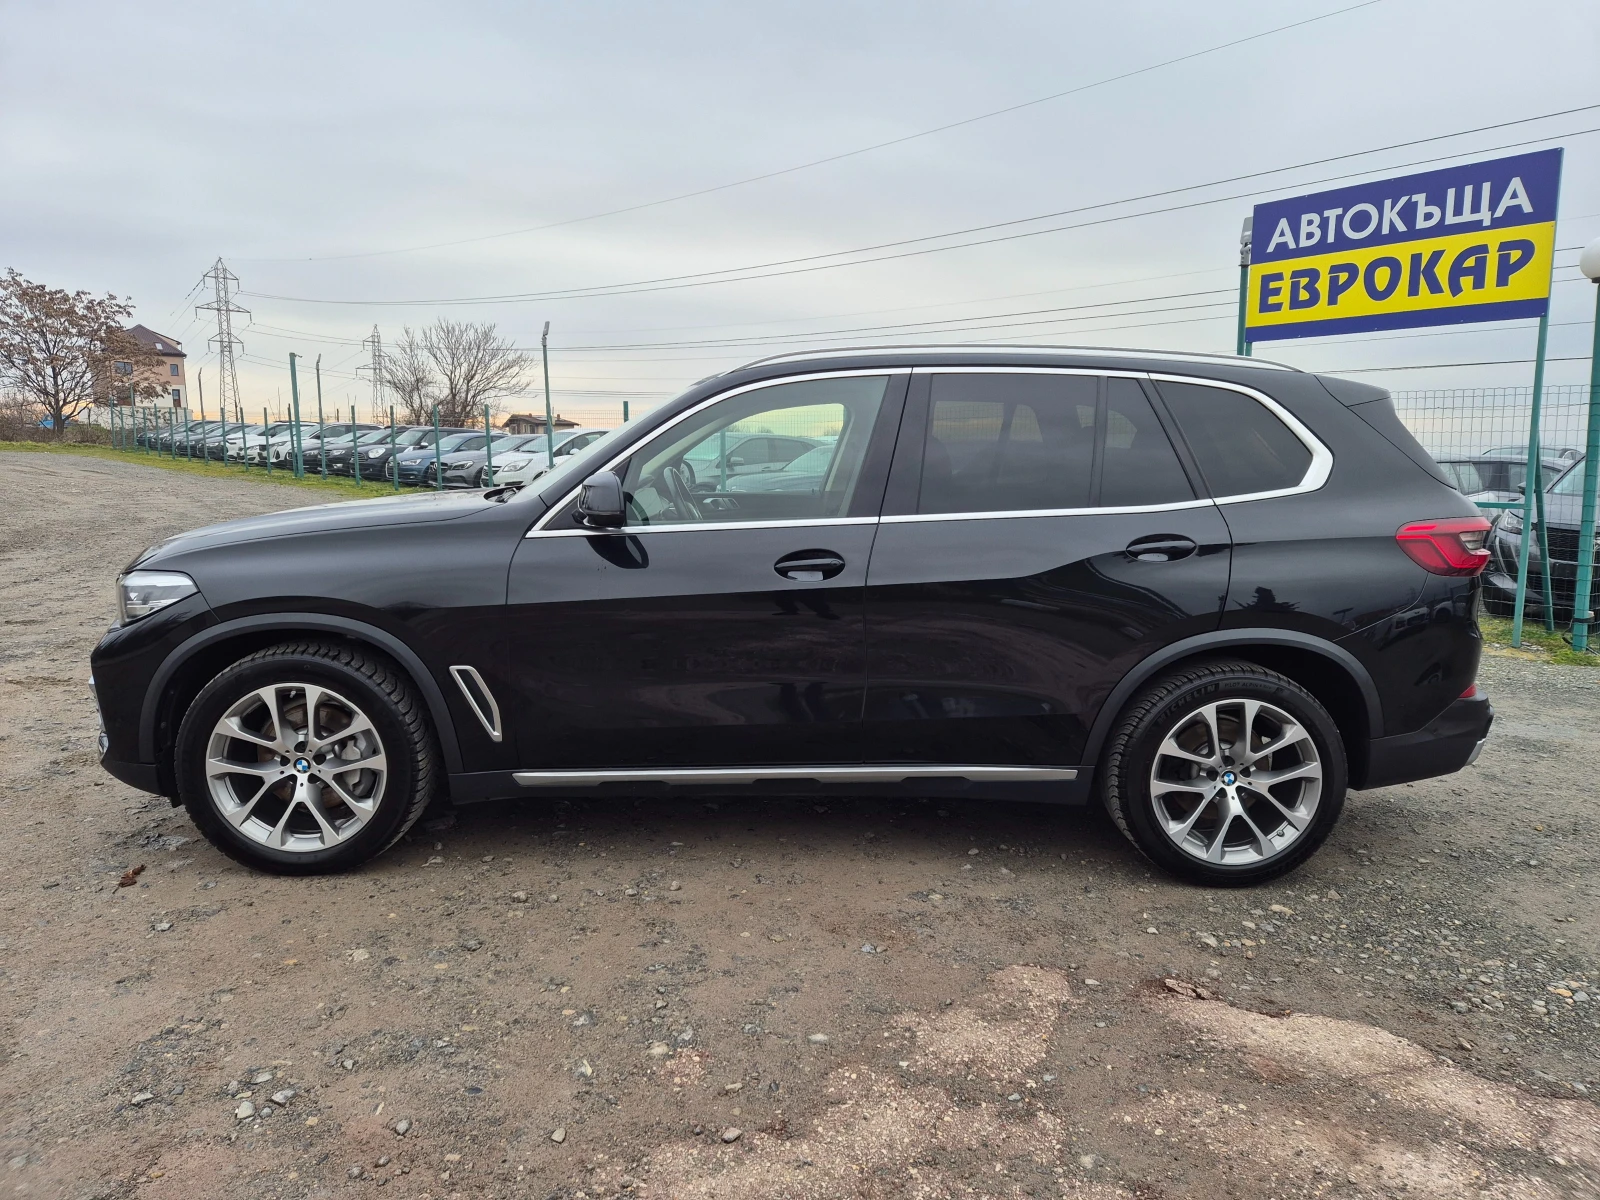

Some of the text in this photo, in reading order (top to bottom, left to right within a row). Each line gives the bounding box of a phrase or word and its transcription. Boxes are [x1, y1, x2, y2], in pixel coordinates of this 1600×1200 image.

[1266, 177, 1534, 252] АВТОКЪЩА
[1258, 239, 1536, 314] ЕВРОКАР
[1157, 684, 1216, 723] MICHELIN
